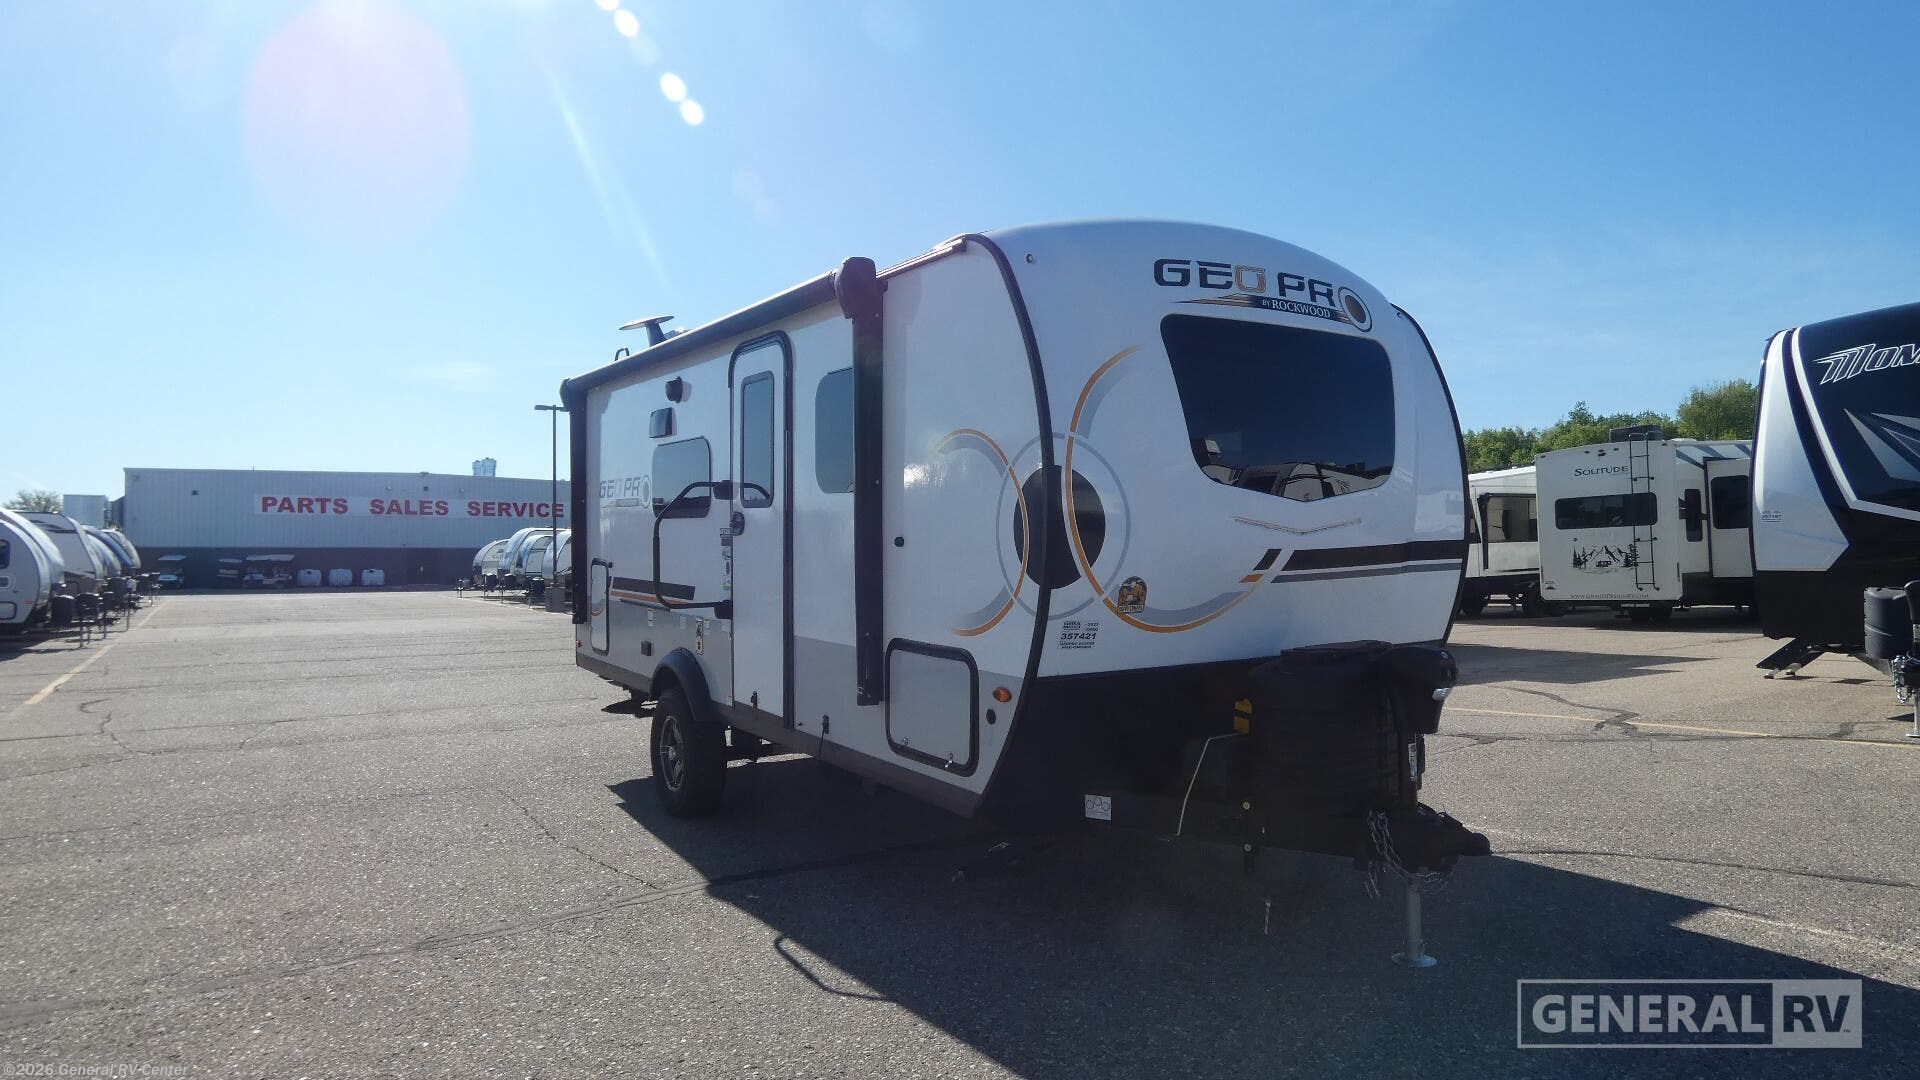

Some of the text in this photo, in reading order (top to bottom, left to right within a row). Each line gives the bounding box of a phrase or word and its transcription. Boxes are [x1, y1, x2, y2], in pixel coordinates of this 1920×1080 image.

[1154, 258, 1373, 333] GEO PRO
[1262, 299, 1331, 318] BY ROCKWOOD
[261, 496, 565, 518] PARTS SALES SERVICE
[1060, 632, 1097, 640] 357421
